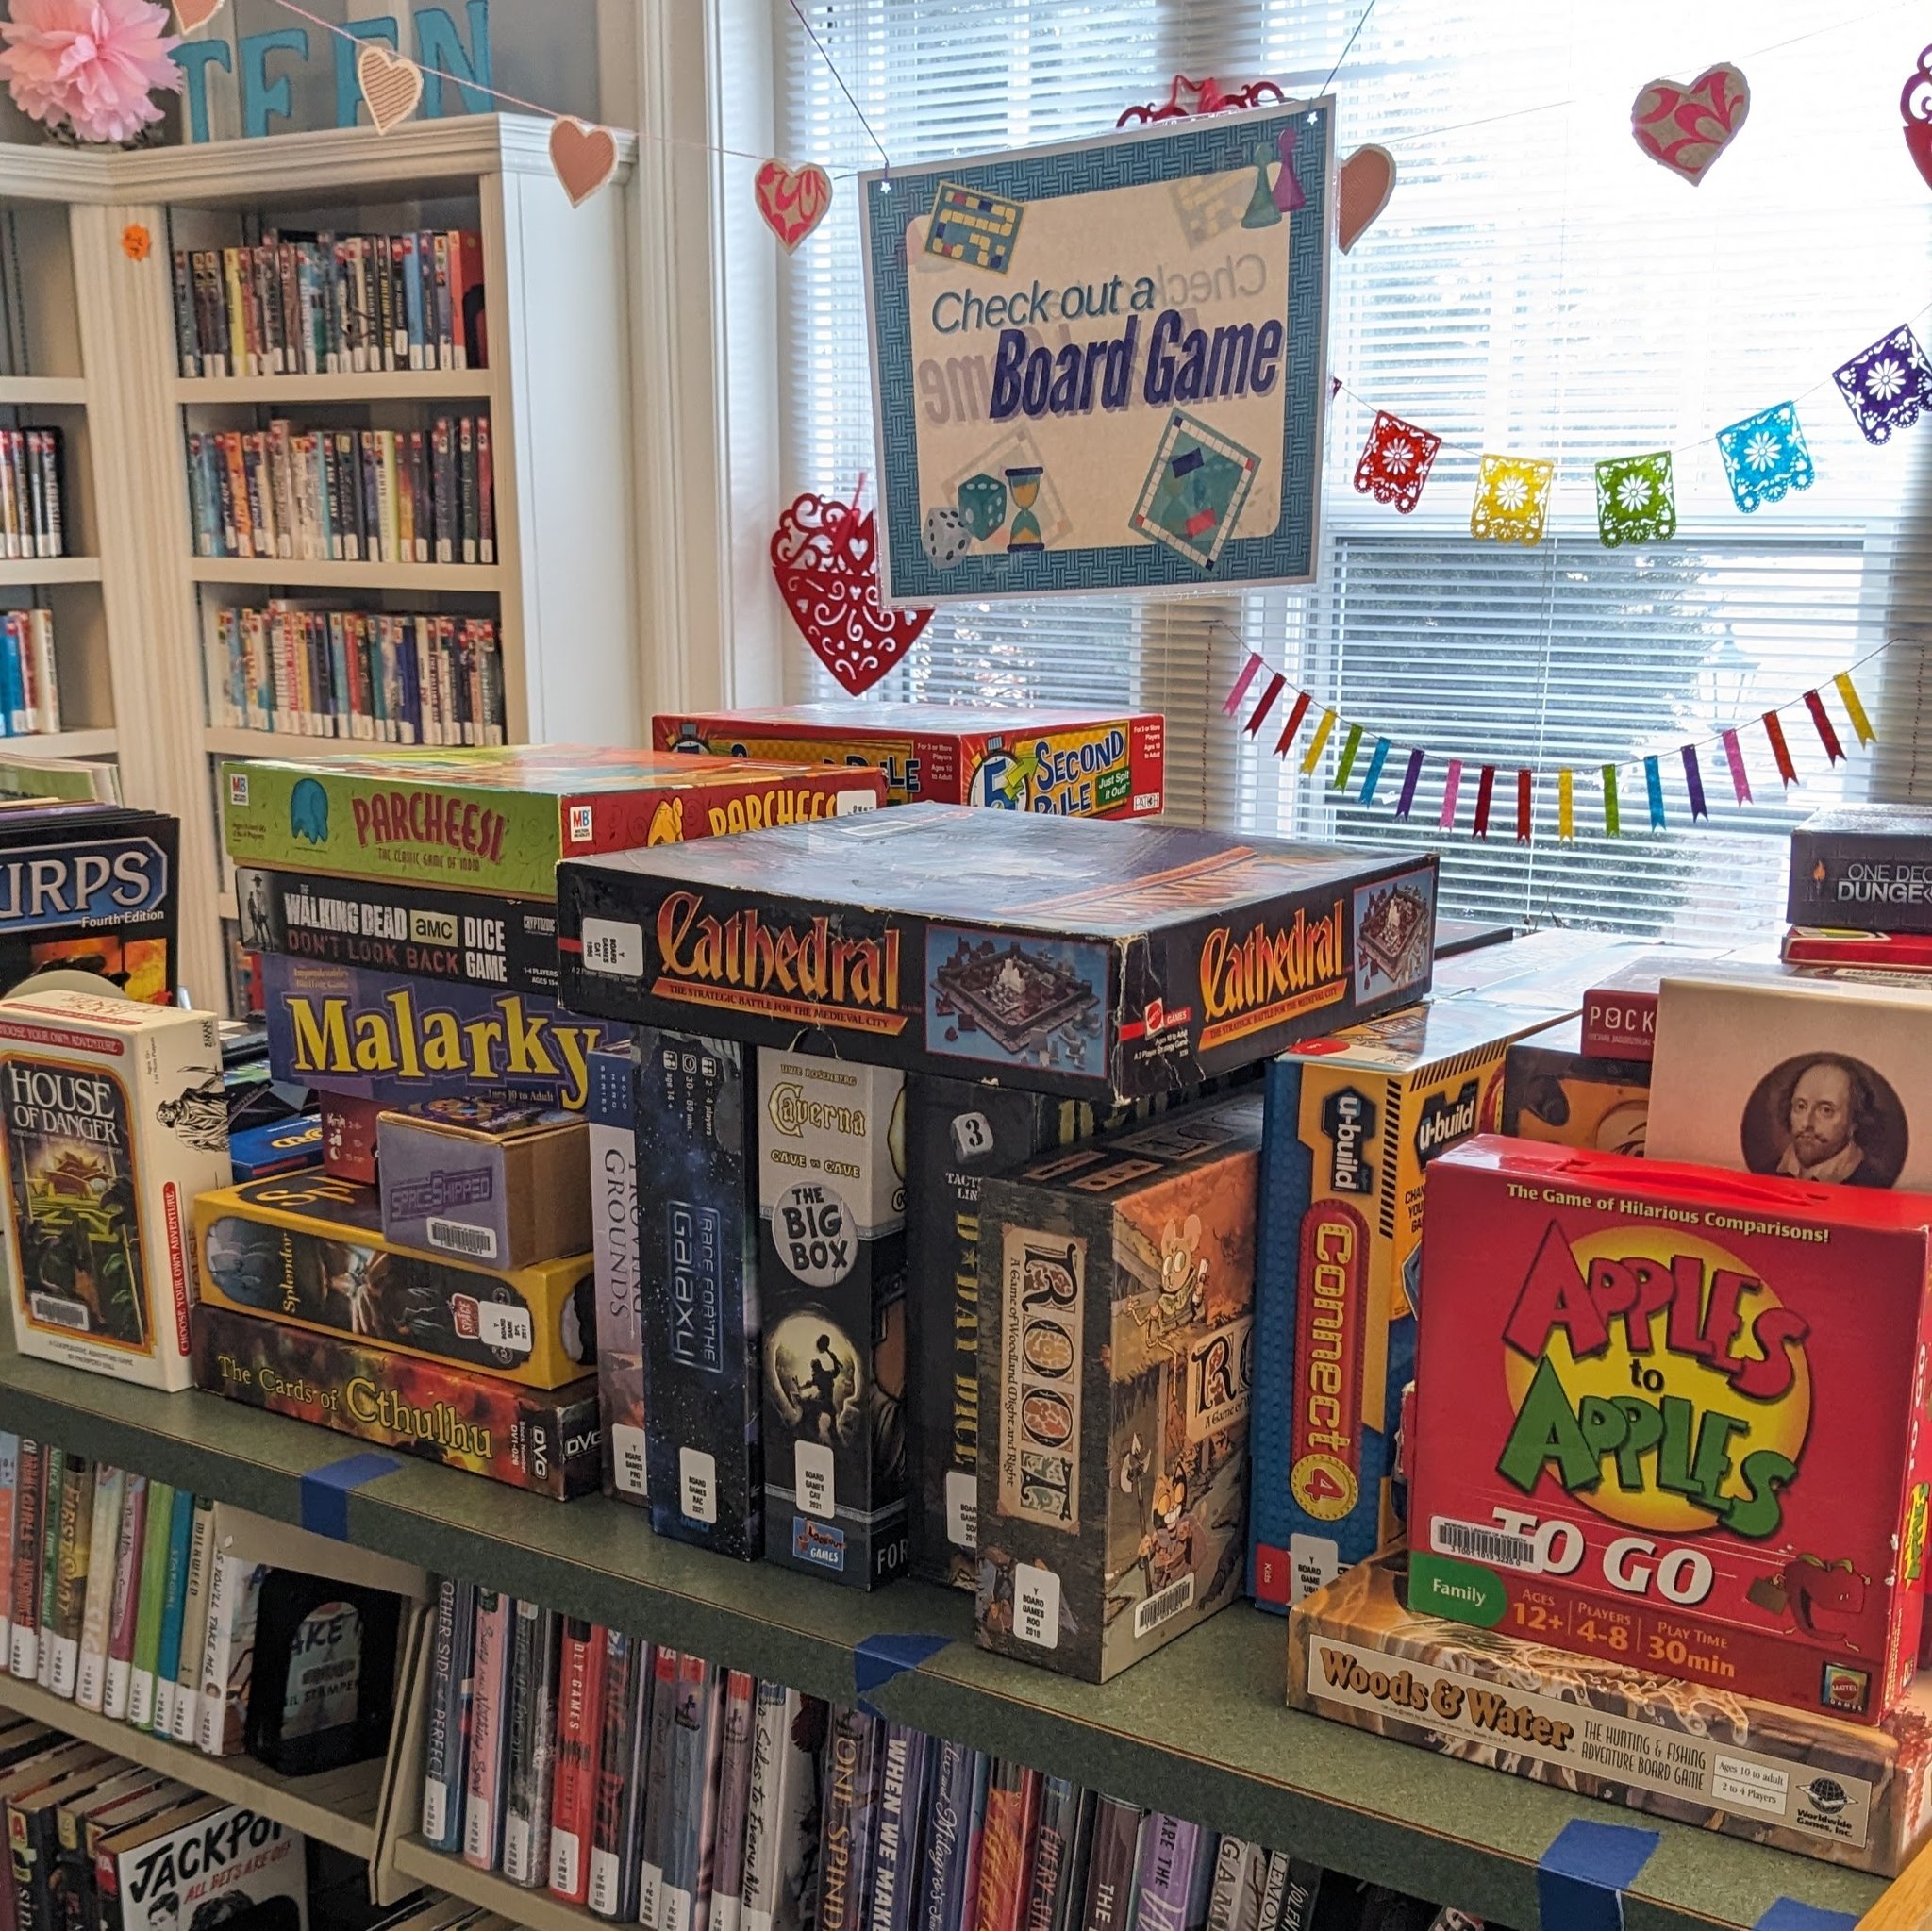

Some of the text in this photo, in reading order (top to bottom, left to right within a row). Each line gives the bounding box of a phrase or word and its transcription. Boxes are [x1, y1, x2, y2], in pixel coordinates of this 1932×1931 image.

[170, 0, 495, 143] TEEN
[932, 275, 1155, 333] Check out a
[989, 309, 1286, 422] Board Game
[1035, 730, 1124, 791] SECOND
[1098, 770, 1130, 790] Just Spit
[352, 791, 508, 865] PARCHEESI
[573, 809, 591, 828] MB
[1848, 863, 1890, 882] ONE
[81, 908, 165, 929] Fourth Edition
[284, 892, 408, 941] WALKING DEAD
[464, 916, 507, 953] DICE
[288, 929, 459, 974] DON'T LOOK BACK
[465, 951, 508, 983] GAME
[593, 941, 602, 957] CAT
[601, 937, 609, 964] GAMES
[657, 891, 901, 1010] Cathedral
[1200, 898, 1344, 1023] Cathedral
[669, 984, 890, 1028] THE STRATEGIC BATTLE FOR THE MEDIEVAL CITY
[1167, 1010, 1188, 1024] GAMES
[287, 990, 602, 1110] Malarky
[9, 1067, 115, 1119] HOUSE
[780, 1063, 857, 1086] UWE ROSENBERG
[14, 1105, 40, 1129] OF
[42, 1109, 120, 1145] DANGER
[768, 1081, 867, 1138] Caverna
[1419, 1101, 1475, 1151] u-build
[964, 1118, 985, 1148] 3
[1334, 1095, 1363, 1190] u-build
[771, 1149, 807, 1168] CAVE
[824, 1160, 860, 1179] CAVE
[791, 1186, 825, 1206] THE
[1508, 1183, 1831, 1244] The Game of Hilarious Comparisons!
[604, 1148, 630, 1319] GROUNDS
[782, 1204, 842, 1240] BIG
[165, 1191, 189, 1352] CHOOSE YOUR OWN ADVENTURE
[281, 1231, 296, 1314] Splendor
[789, 1240, 849, 1271] BOX
[701, 1216, 716, 1362] RACE FOR THE
[1008, 1269, 1020, 1307] Game
[458, 1300, 473, 1333] SPACE
[1502, 1218, 1811, 1403] APPLES
[1008, 1323, 1020, 1385] Woodland
[1307, 1221, 1353, 1452] Connect
[1019, 1242, 1079, 1522] ROOT
[1628, 1358, 1665, 1393] to
[217, 1353, 493, 1459] The Cards of Cthulhu
[1005, 1387, 1018, 1425] Might
[533, 1426, 548, 1479] DVG
[1007, 1427, 1018, 1450] and
[1496, 1355, 1799, 1539] APPLES
[625, 1461, 643, 1472] GAMES
[689, 1475, 707, 1488] BOARD
[805, 1470, 824, 1483] BOARD
[805, 1479, 824, 1492] GAMES
[1005, 1452, 1018, 1488] Right
[1302, 1467, 1347, 1503] 4
[688, 1485, 707, 1497] GAMES
[809, 1490, 822, 1501] CAV
[190, 1522, 205, 1596] MILKWEED
[810, 1546, 840, 1564] GAMES
[1263, 1561, 1272, 1585] Kids
[1298, 1563, 1322, 1576] BOARD
[1603, 1537, 1715, 1605] GO
[167, 1549, 180, 1611] STARGIRL
[1300, 1573, 1321, 1586] GAME
[1433, 1578, 1487, 1607] Family
[1522, 1588, 1556, 1606] AGES
[438, 1580, 456, 1640] OTHER
[1023, 1594, 1044, 1607] BOARD
[1023, 1605, 1044, 1620] GAMES
[1513, 1602, 1565, 1633] 12+
[1577, 1600, 1632, 1626] PLAYERS
[1026, 1616, 1041, 1628] ROO
[1576, 1619, 1630, 1652] 4-8
[1657, 1620, 1730, 1650] PLAY TIME
[436, 1642, 453, 1682] SIDE
[1648, 1634, 1737, 1679] 30min
[568, 1679, 583, 1731] GAMES
[1319, 1647, 1429, 1711] Woods
[1430, 1678, 1466, 1720] &
[1466, 1687, 1575, 1751] Water
[1828, 1696, 1864, 1714] GAMES
[1830, 1683, 1858, 1694] MATTEL
[428, 1708, 448, 1777] PERFECT
[1584, 1720, 1707, 1771] THE HUNTING & FISHING
[882, 1738, 908, 1814] WHEN
[1581, 1741, 1705, 1791] ADVENTURE BOARD GAME
[1719, 1761, 1785, 1787] Ages 10 to adult
[1729, 1784, 1739, 1795] to
[1746, 1788, 1777, 1806] Players
[1795, 1808, 1853, 1830] Worldwide
[1795, 1818, 1854, 1839] Games, Inc.
[878, 1821, 900, 1862] WE
[1154, 1816, 1178, 1889] ARE THE
[184, 1841, 293, 1906] ALL BETS ARE OFF
[1094, 1883, 1115, 1923] THE
